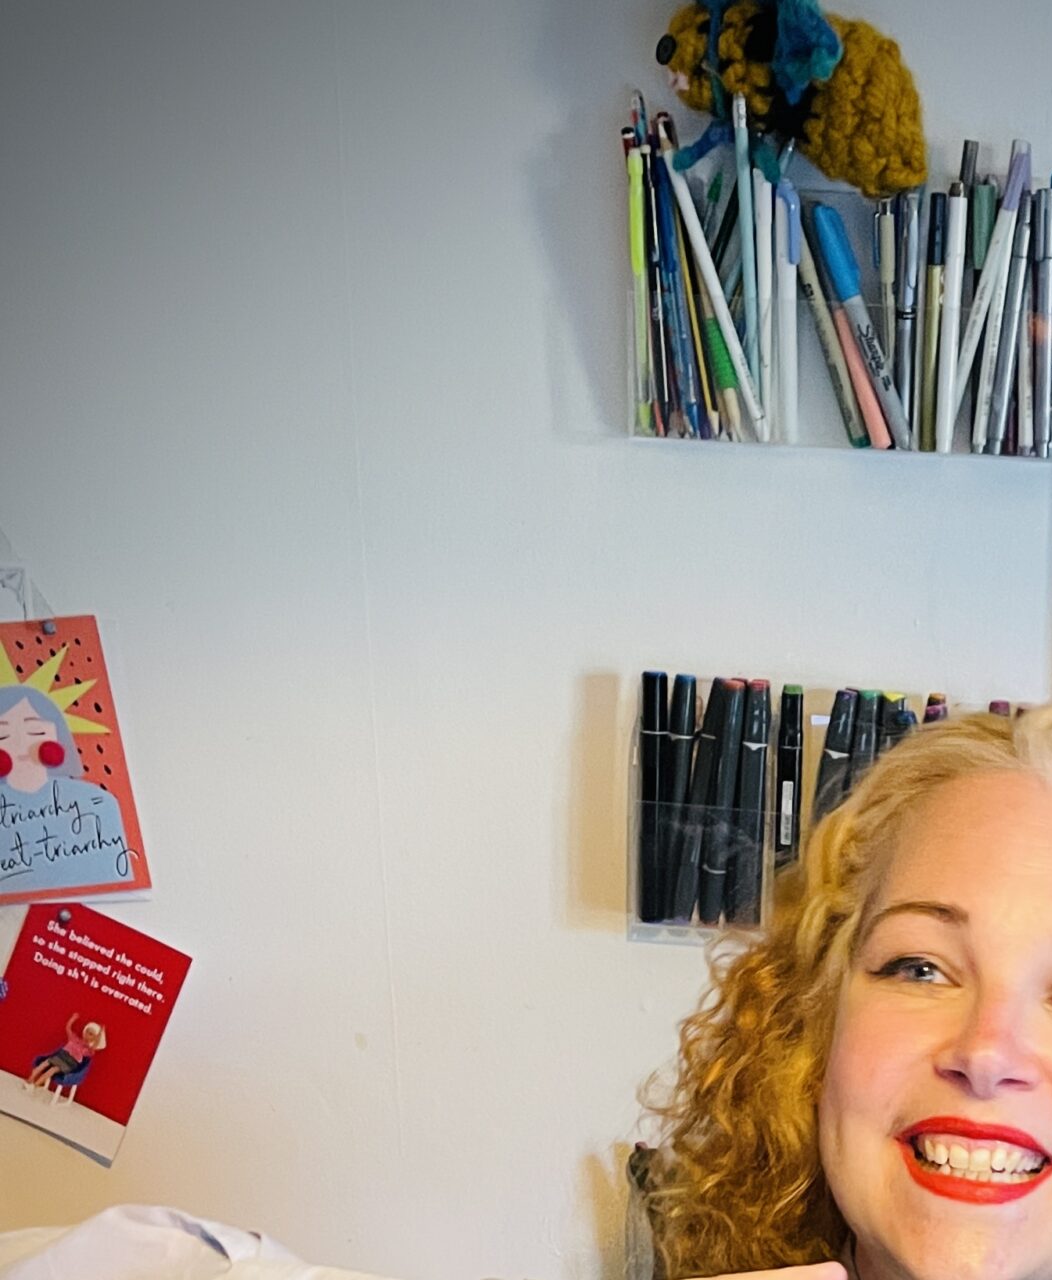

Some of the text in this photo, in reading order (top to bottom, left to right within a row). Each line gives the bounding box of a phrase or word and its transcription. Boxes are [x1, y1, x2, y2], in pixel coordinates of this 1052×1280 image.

[32, 935, 165, 1003] so she stopped right there.
[33, 952, 65, 975] Doing
[90, 977, 99, 989] is
[101, 985, 153, 1015] overrated.
[47, 920, 164, 985] She believed she could,
